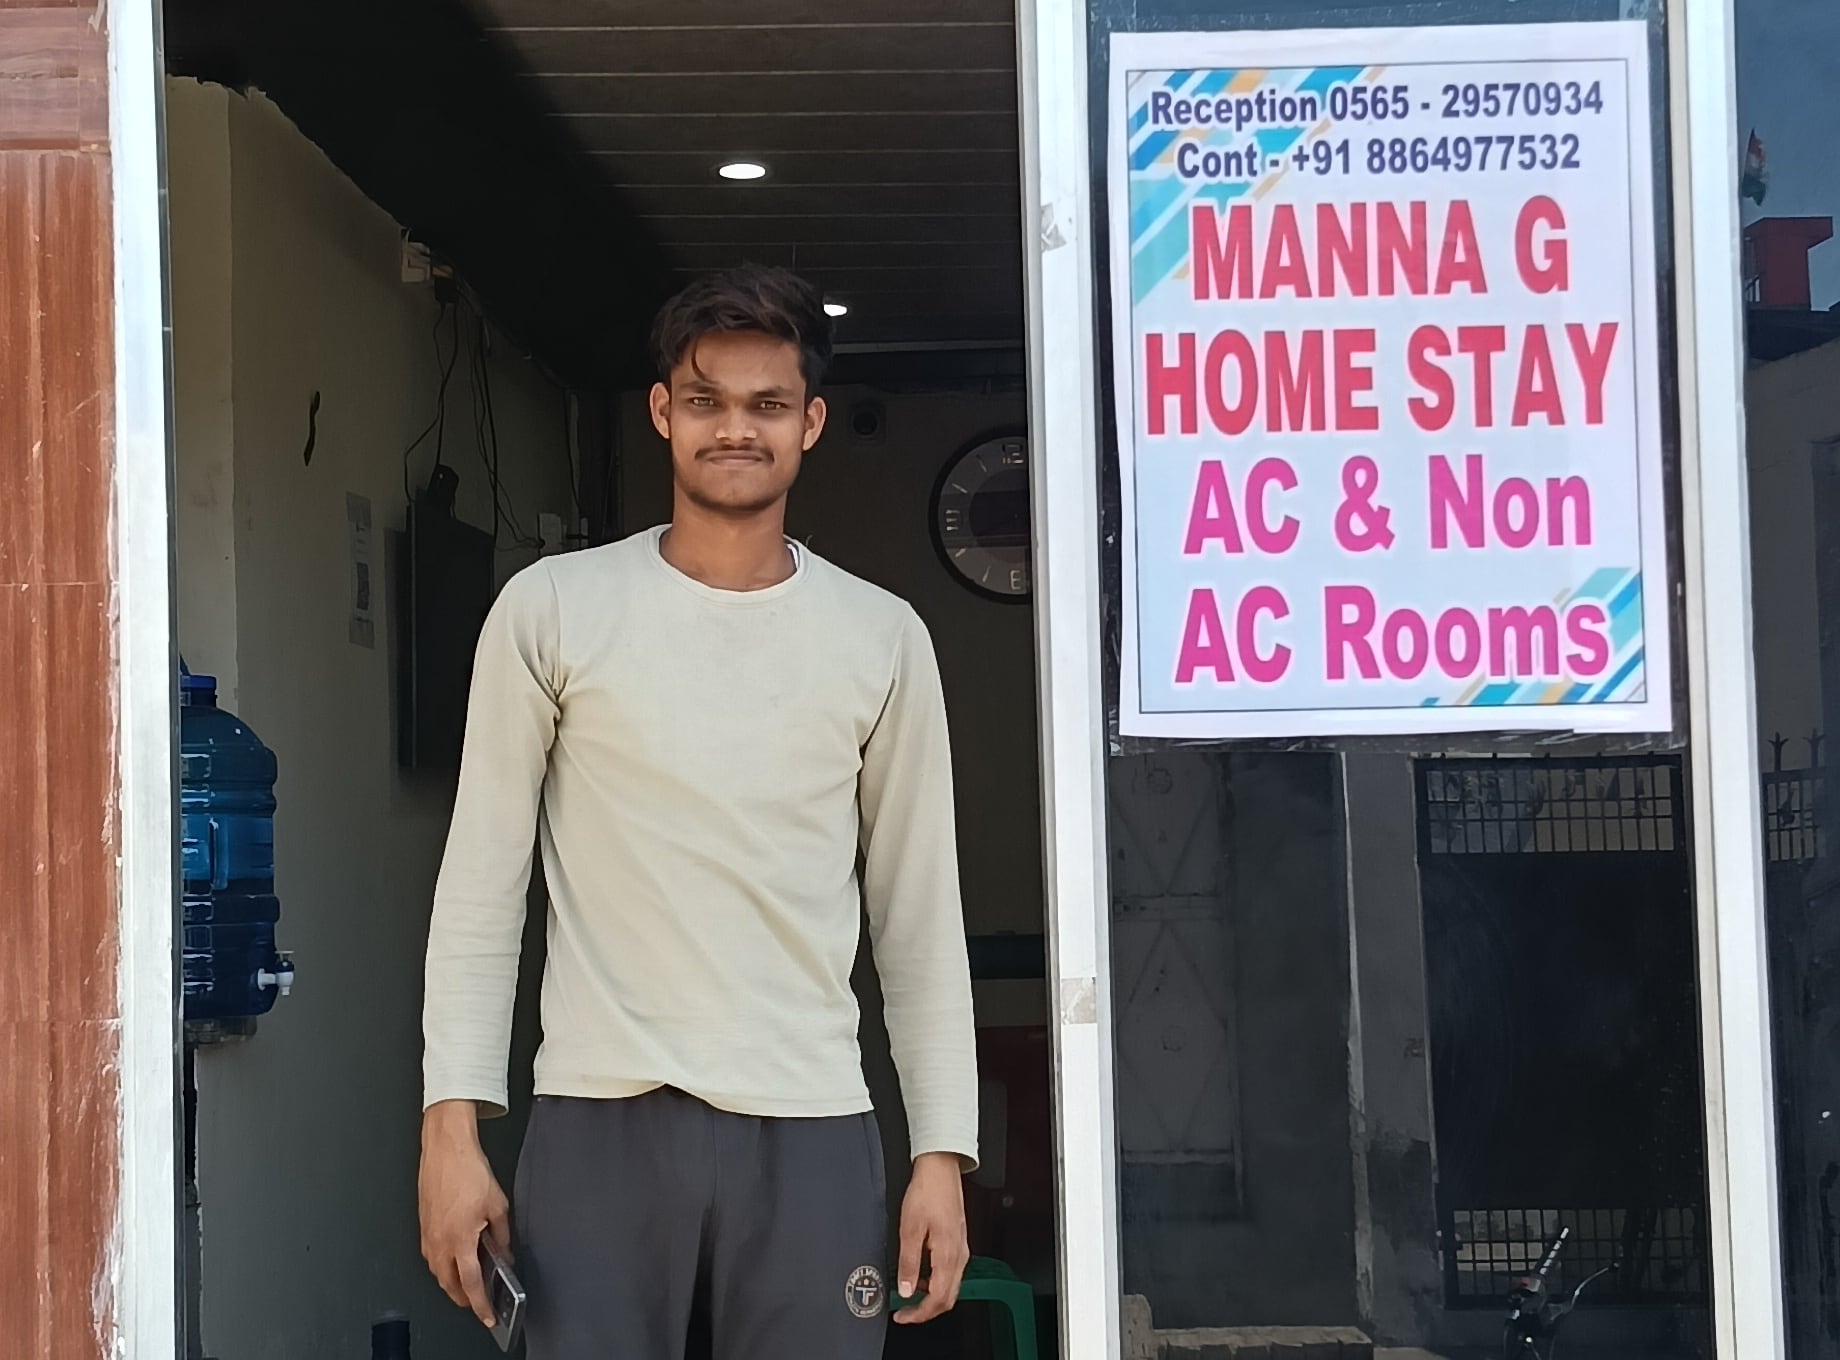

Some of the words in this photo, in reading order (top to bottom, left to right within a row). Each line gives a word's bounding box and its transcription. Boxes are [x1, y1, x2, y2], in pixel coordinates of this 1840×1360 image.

[1151, 89, 1318, 133] Reception
[1330, 85, 1410, 121] 0565
[1442, 81, 1603, 118] 29570934
[1177, 142, 1257, 178] Cont
[1292, 139, 1351, 176] +91
[1367, 134, 1581, 174] 8864977532
[1193, 199, 1487, 301] MANNA
[1516, 195, 1569, 294] G
[1145, 328, 1379, 436] HOME
[1407, 322, 1619, 432] STAY
[1183, 458, 1300, 554] AC
[1335, 455, 1395, 551] &
[1429, 454, 1592, 548] Non
[1174, 586, 1292, 683] AC
[1324, 586, 1610, 680] Rooms
